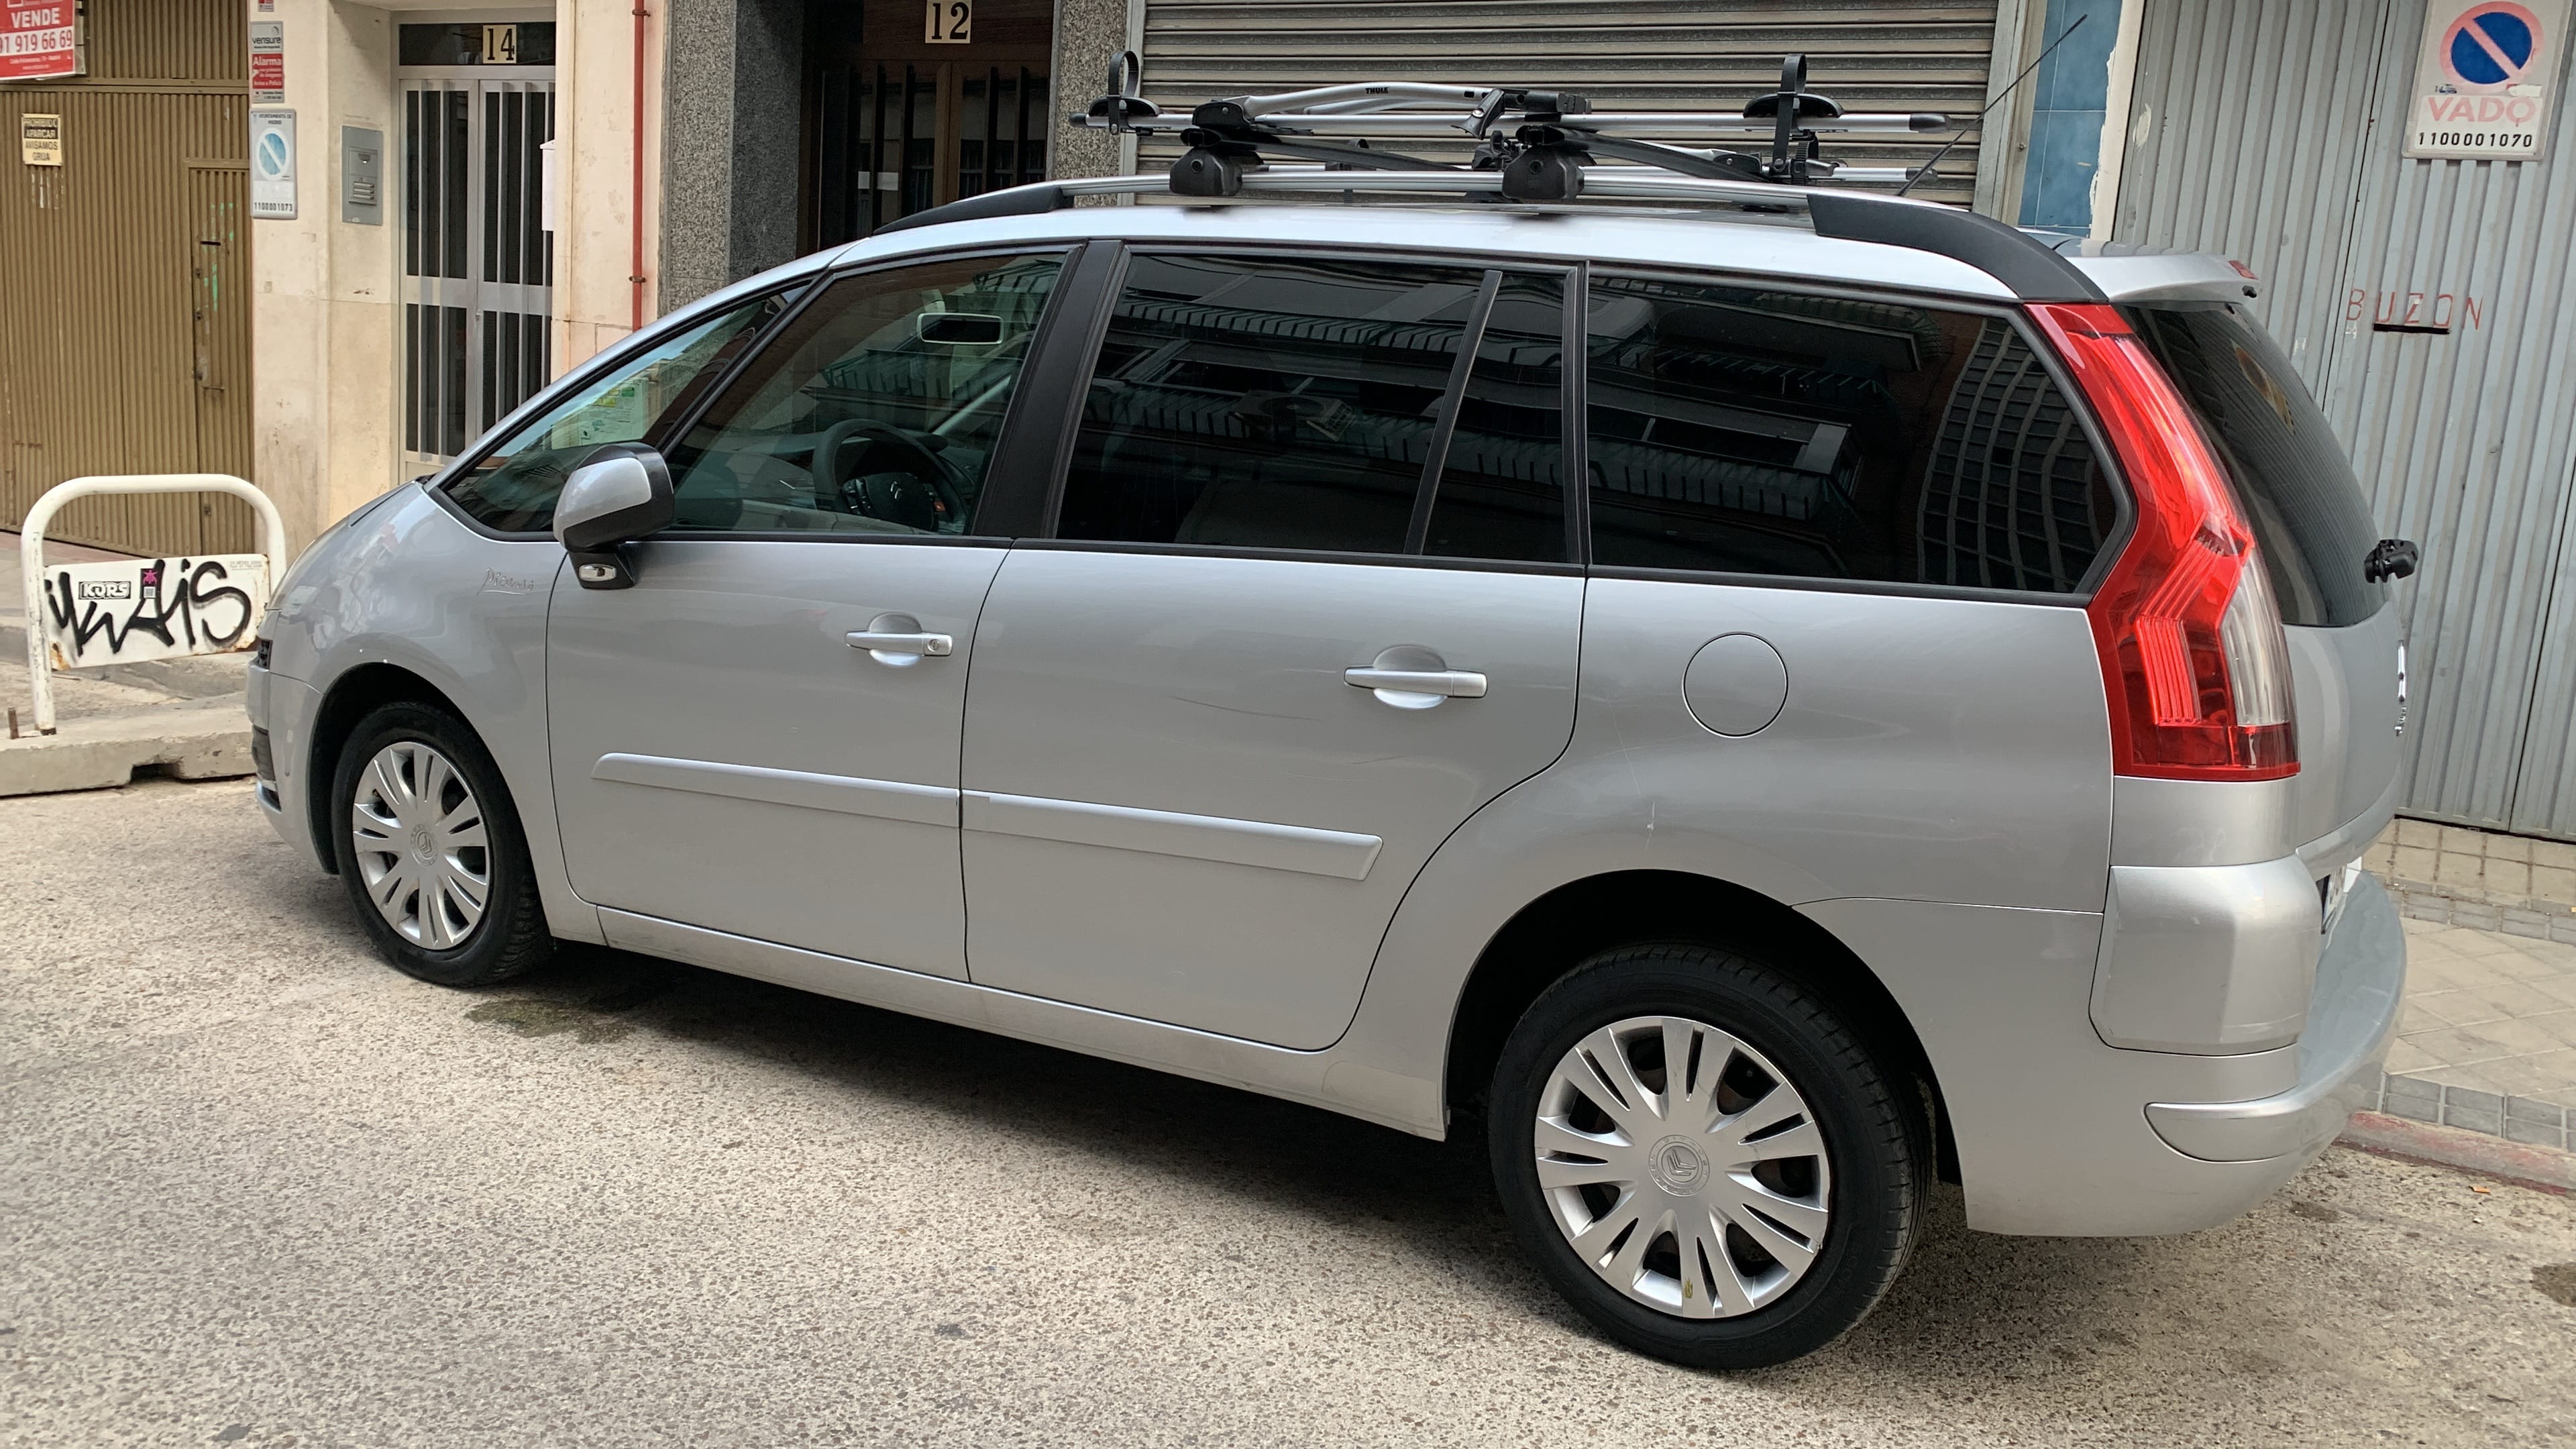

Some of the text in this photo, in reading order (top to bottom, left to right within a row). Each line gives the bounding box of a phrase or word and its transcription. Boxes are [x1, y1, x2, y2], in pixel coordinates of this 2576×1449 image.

[11, 7, 60, 29] VENDE
[931, 2, 969, 40] 12
[15, 34, 38, 52] 919
[42, 32, 55, 50] 66
[60, 30, 72, 48] 69
[487, 28, 515, 60] 14
[253, 56, 281, 66] Alarma
[1365, 87, 1389, 95] THULE
[2428, 97, 2536, 123] VADO
[26, 129, 56, 138] APARCAR
[2419, 132, 2532, 147] 1100001070
[25, 140, 58, 150] AVISAMOS
[254, 203, 292, 212] 1100001073
[2346, 289, 2483, 330] BUZON
